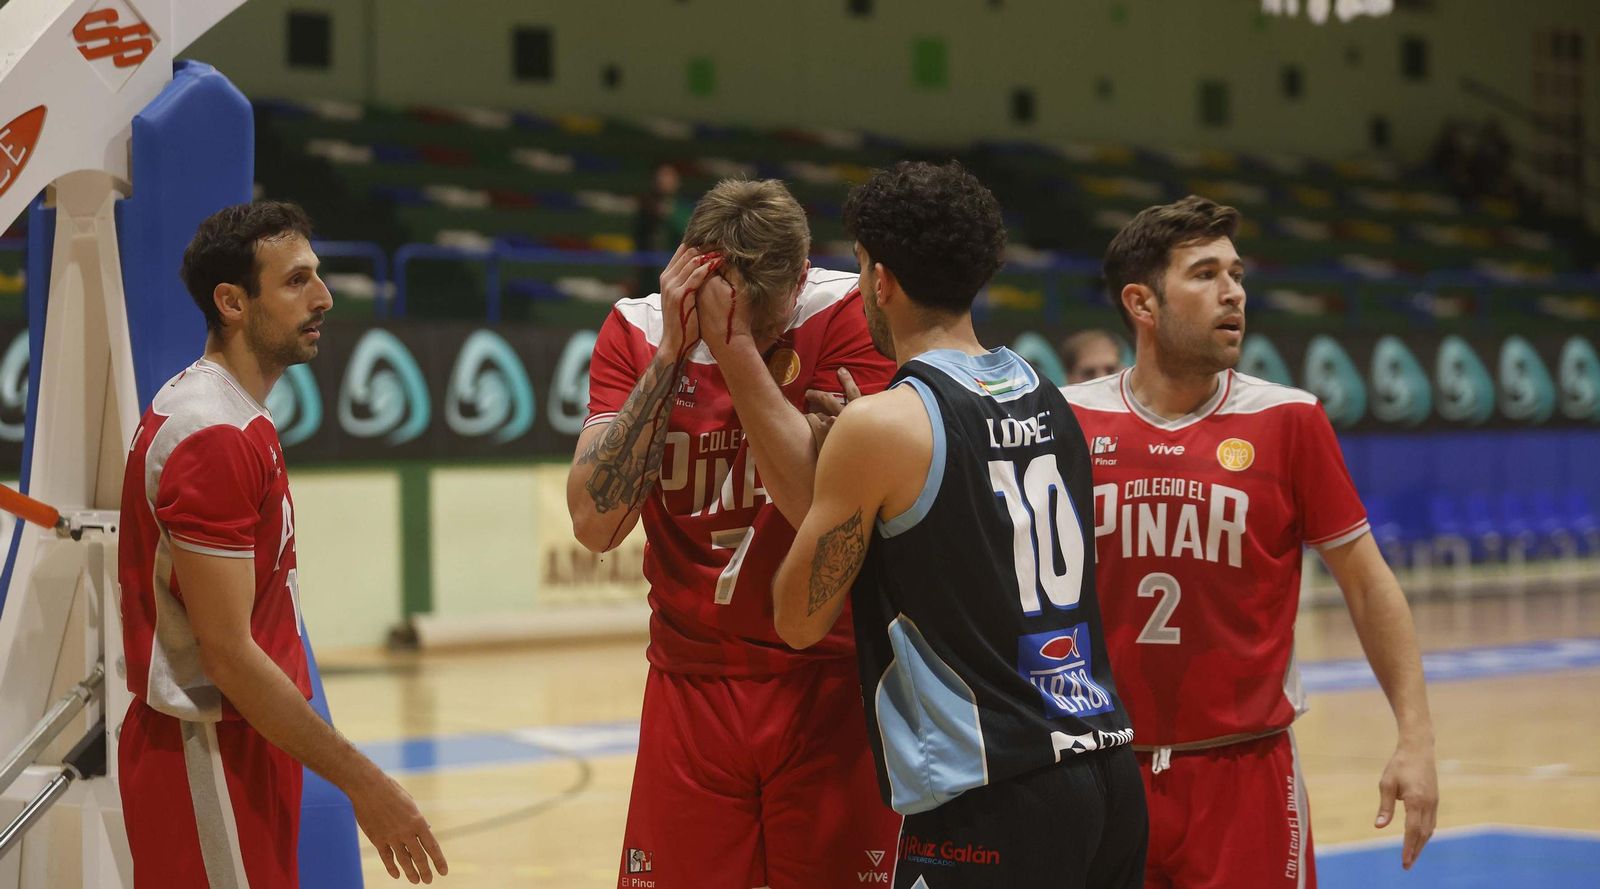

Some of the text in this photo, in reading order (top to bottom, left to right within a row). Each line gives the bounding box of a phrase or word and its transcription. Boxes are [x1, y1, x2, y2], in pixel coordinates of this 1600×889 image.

[658, 431, 773, 516] PINA
[700, 429, 746, 454] COLE
[1148, 442, 1186, 456] vive
[1093, 482, 1250, 569] PINAR
[1124, 477, 1206, 502] COLEGIO EL
[711, 525, 755, 605] 7
[988, 454, 1085, 617] 10
[1135, 572, 1182, 645] 2
